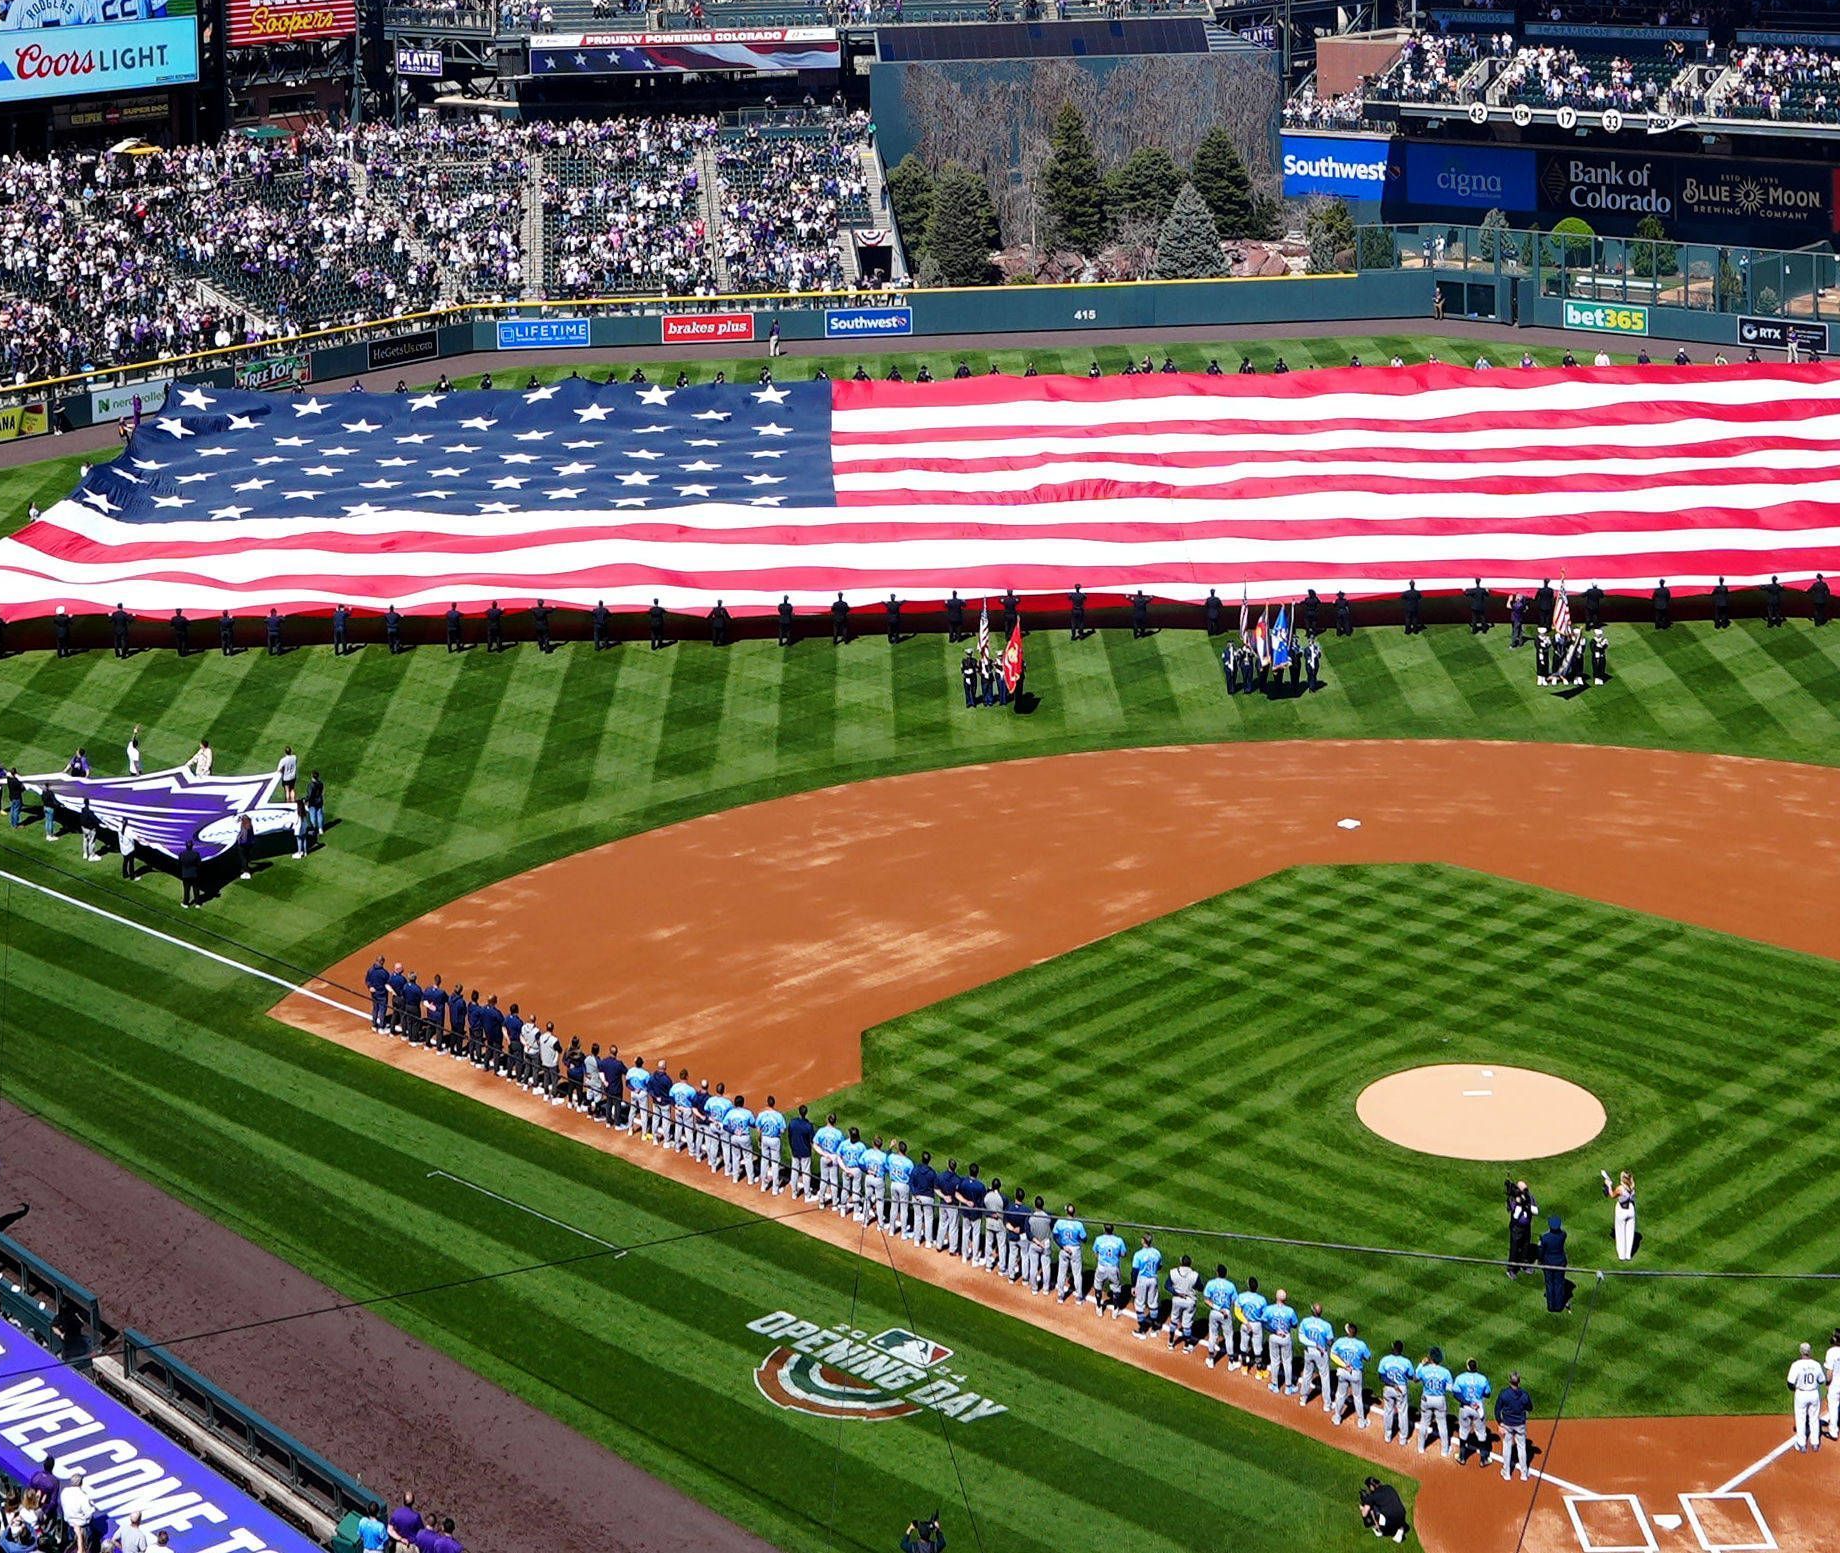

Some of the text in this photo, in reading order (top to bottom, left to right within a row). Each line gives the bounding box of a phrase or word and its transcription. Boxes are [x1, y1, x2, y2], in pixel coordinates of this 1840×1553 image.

[250, 6, 334, 39] Soopers
[585, 35, 643, 46] PROUDLY
[645, 33, 713, 45] POWERING
[714, 31, 784, 43] COLORADO
[15, 43, 96, 80] Coors
[399, 52, 440, 67] PLATTE
[1470, 108, 1483, 121] 42
[1560, 111, 1573, 126] 17
[1605, 115, 1619, 129] 33
[1283, 154, 1387, 181] Southwest
[1569, 160, 1651, 187] Bank of
[1436, 167, 1502, 196] cigna
[1570, 184, 1672, 214] Colorado
[1683, 178, 1821, 208] BLUE MOON
[1693, 204, 1808, 221] BREWING COMPANY
[830, 315, 898, 330] Southwest
[1074, 309, 1097, 320] 415
[1566, 304, 1645, 331] bet365
[515, 323, 586, 338] LIFETIME
[668, 321, 747, 336] brakes plus
[1759, 327, 1782, 341] RTX
[373, 341, 434, 362] HeGetsUs.com
[244, 362, 294, 389] TREE TOP
[746, 1310, 1009, 1424] OPENING DAY
[1802, 1373, 1815, 1385] 10
